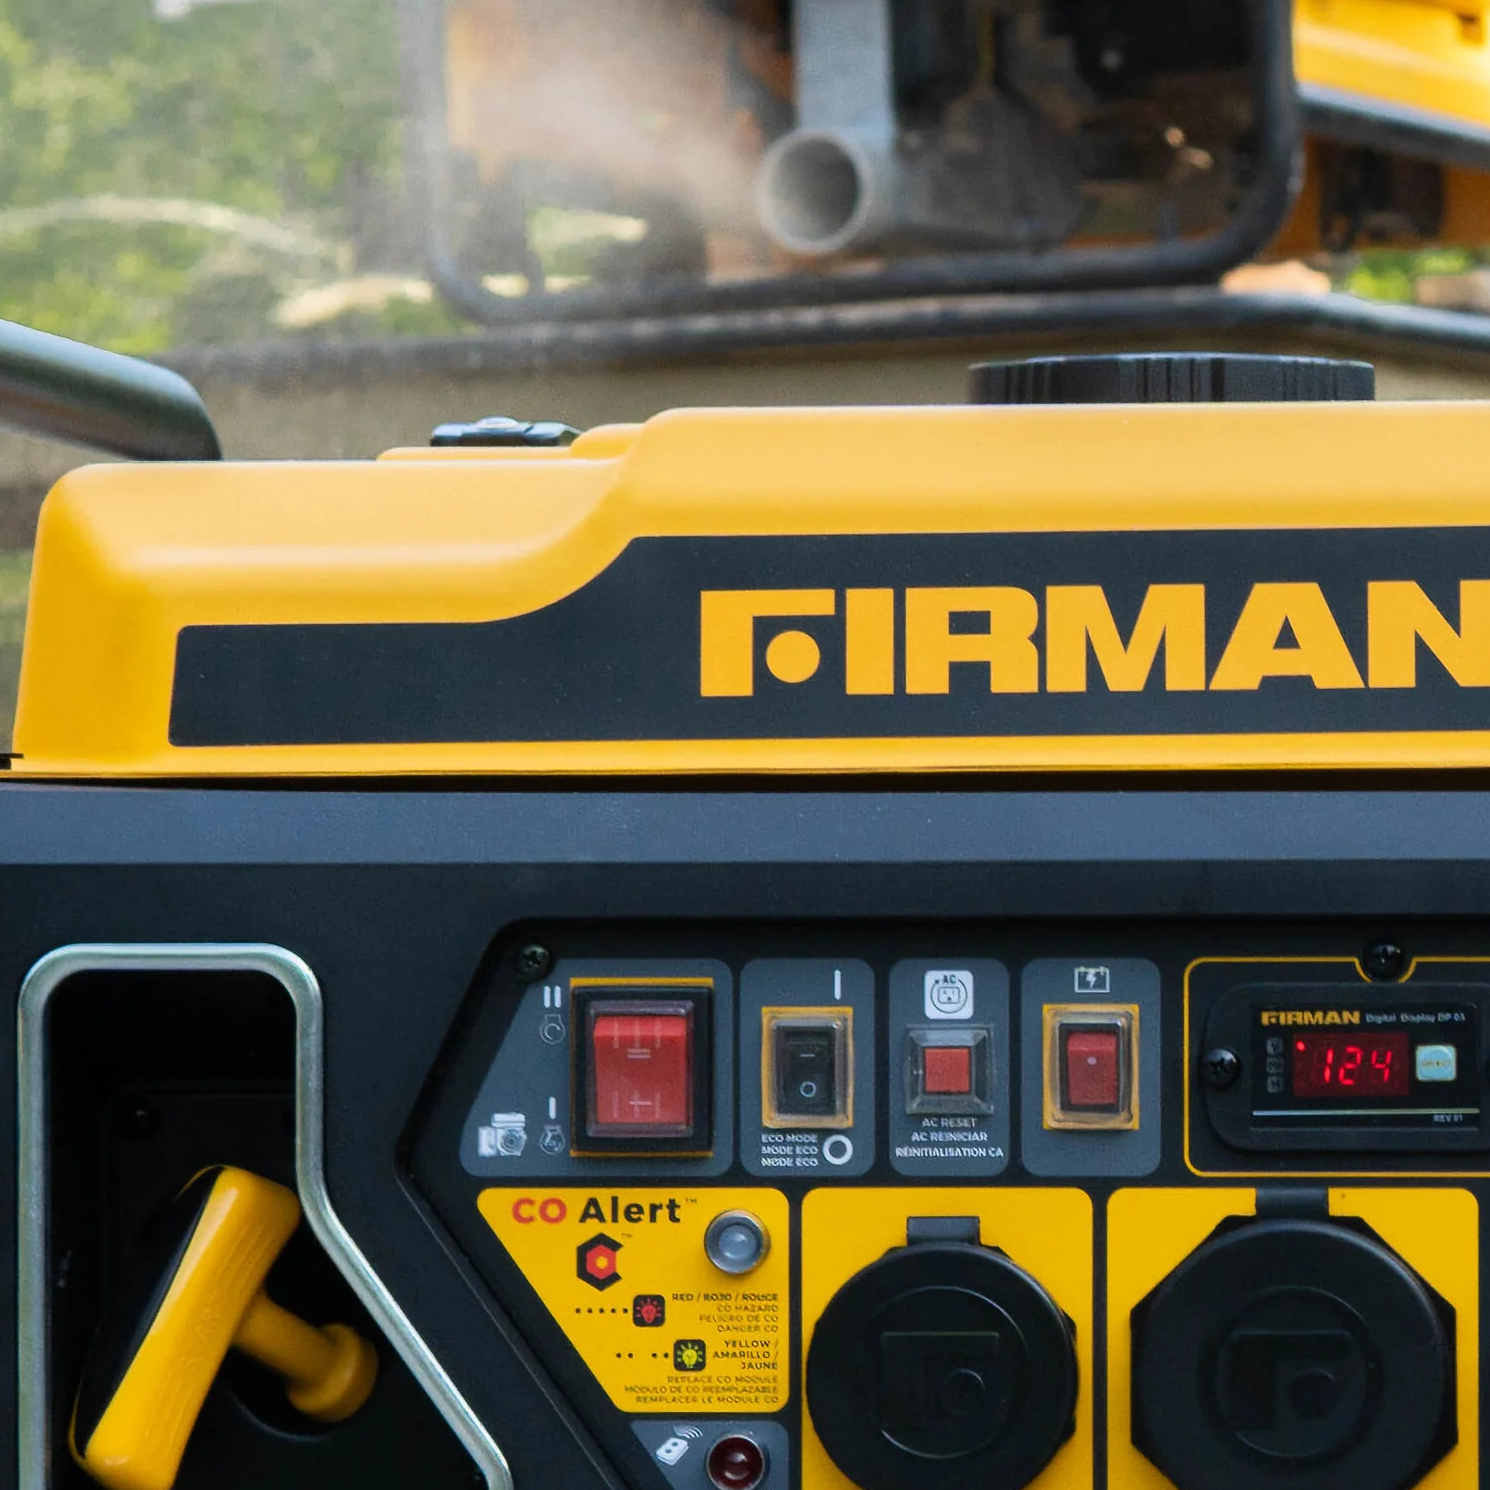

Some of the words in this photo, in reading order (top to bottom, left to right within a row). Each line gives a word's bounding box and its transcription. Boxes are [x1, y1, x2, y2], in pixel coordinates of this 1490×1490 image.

[942, 974, 956, 983] AC
[1262, 1011, 1360, 1025] FIRMAN
[1324, 1046, 1392, 1085] 124
[512, 1197, 567, 1223] CO
